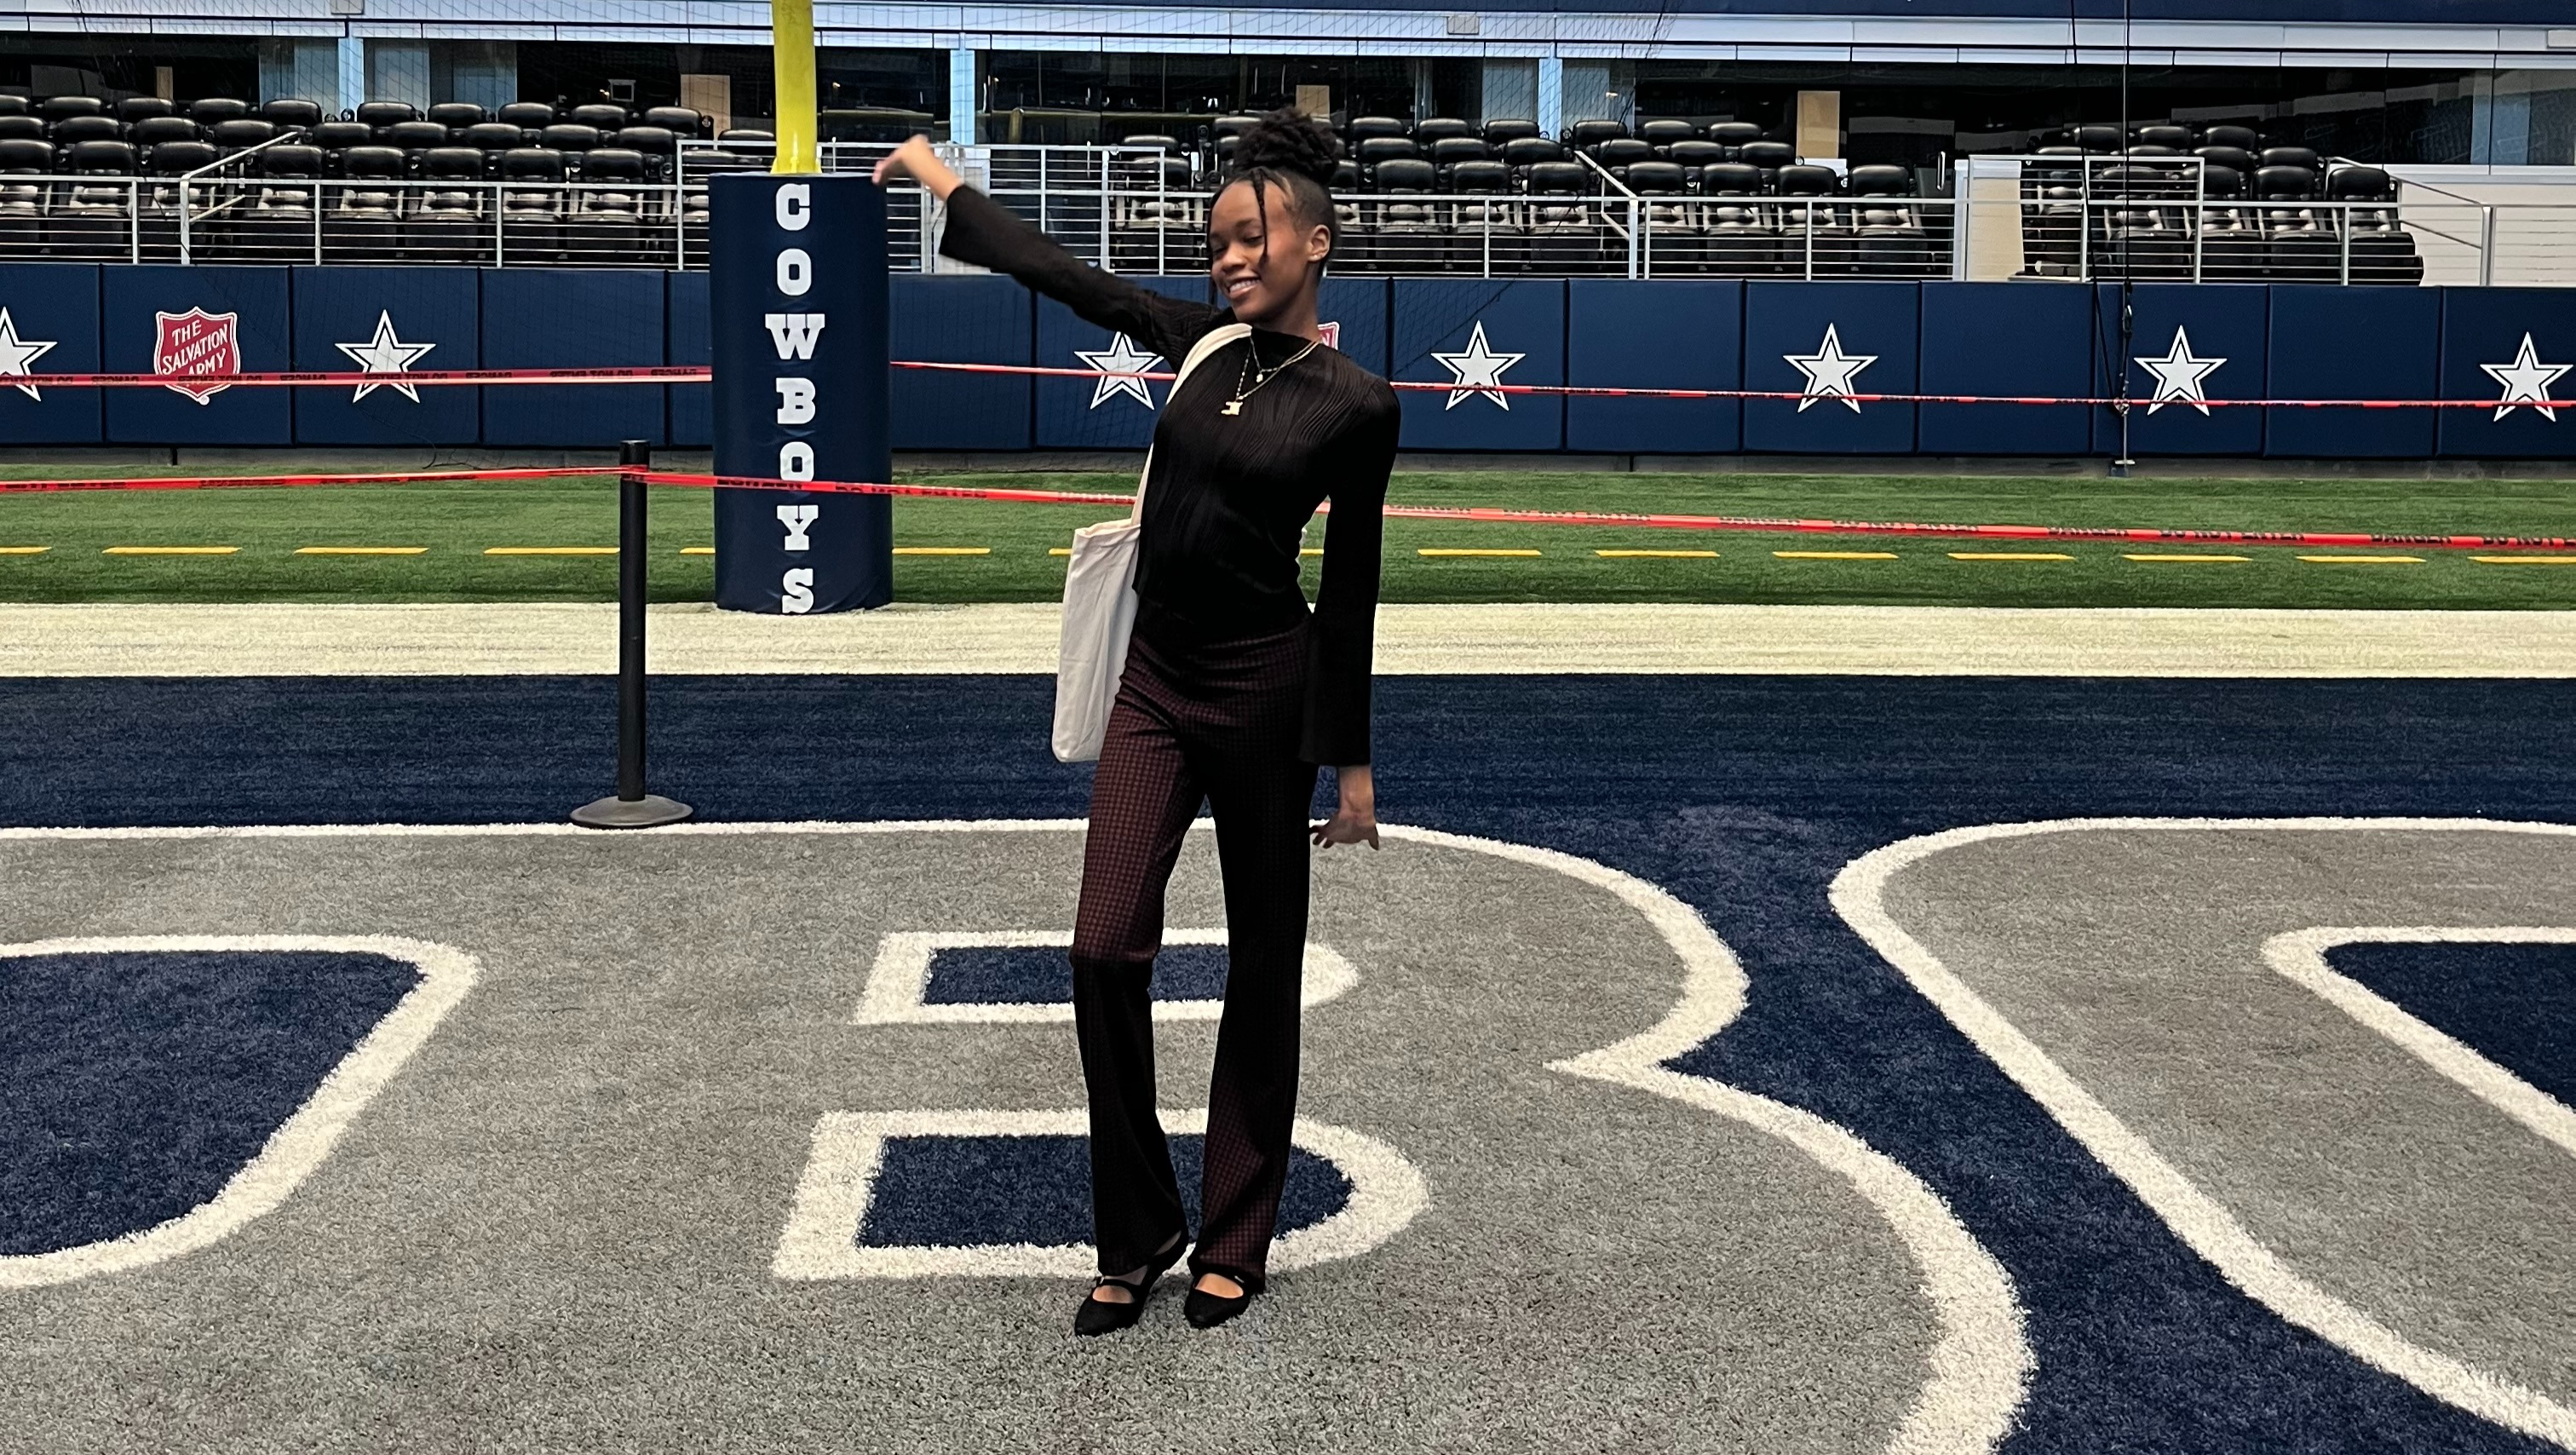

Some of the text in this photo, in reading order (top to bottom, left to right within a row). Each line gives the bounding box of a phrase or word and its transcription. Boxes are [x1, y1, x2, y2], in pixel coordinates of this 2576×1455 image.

[162, 324, 227, 375] SALVATION
[172, 319, 202, 346] THE
[188, 348, 226, 375] ARMY
[765, 183, 825, 614] COWBOYS
